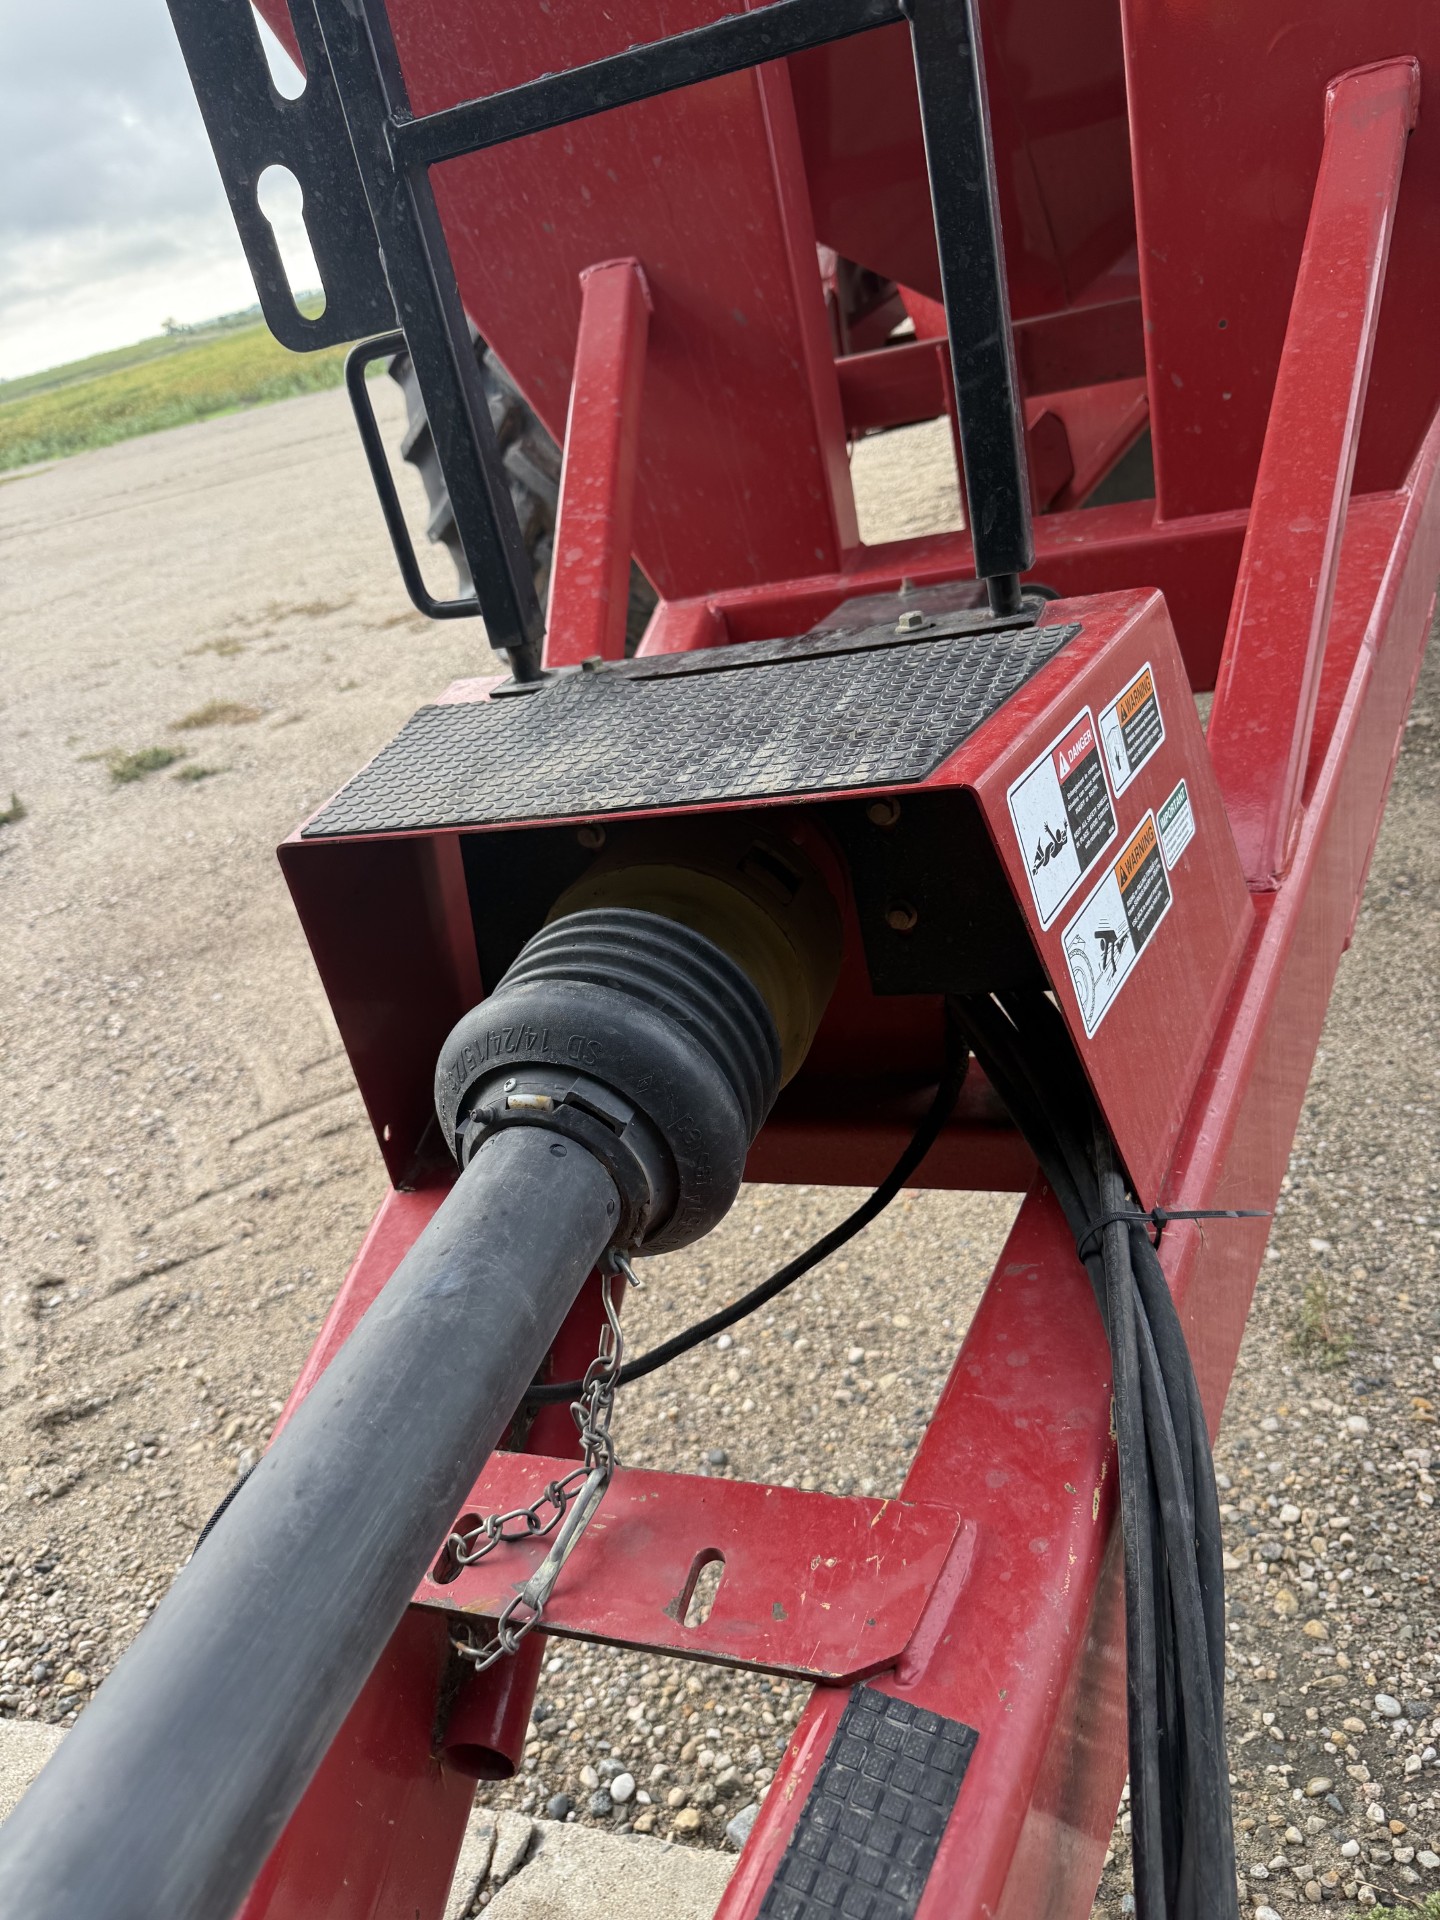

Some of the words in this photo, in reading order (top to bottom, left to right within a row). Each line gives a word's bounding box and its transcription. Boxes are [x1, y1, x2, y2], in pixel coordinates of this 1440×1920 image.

[1125, 676, 1152, 711] WARNING
[1068, 729, 1092, 763] DANGER
[1160, 787, 1185, 830] IMPORTANT
[1124, 827, 1154, 876] WARNING
[567, 1035, 602, 1066] SD
